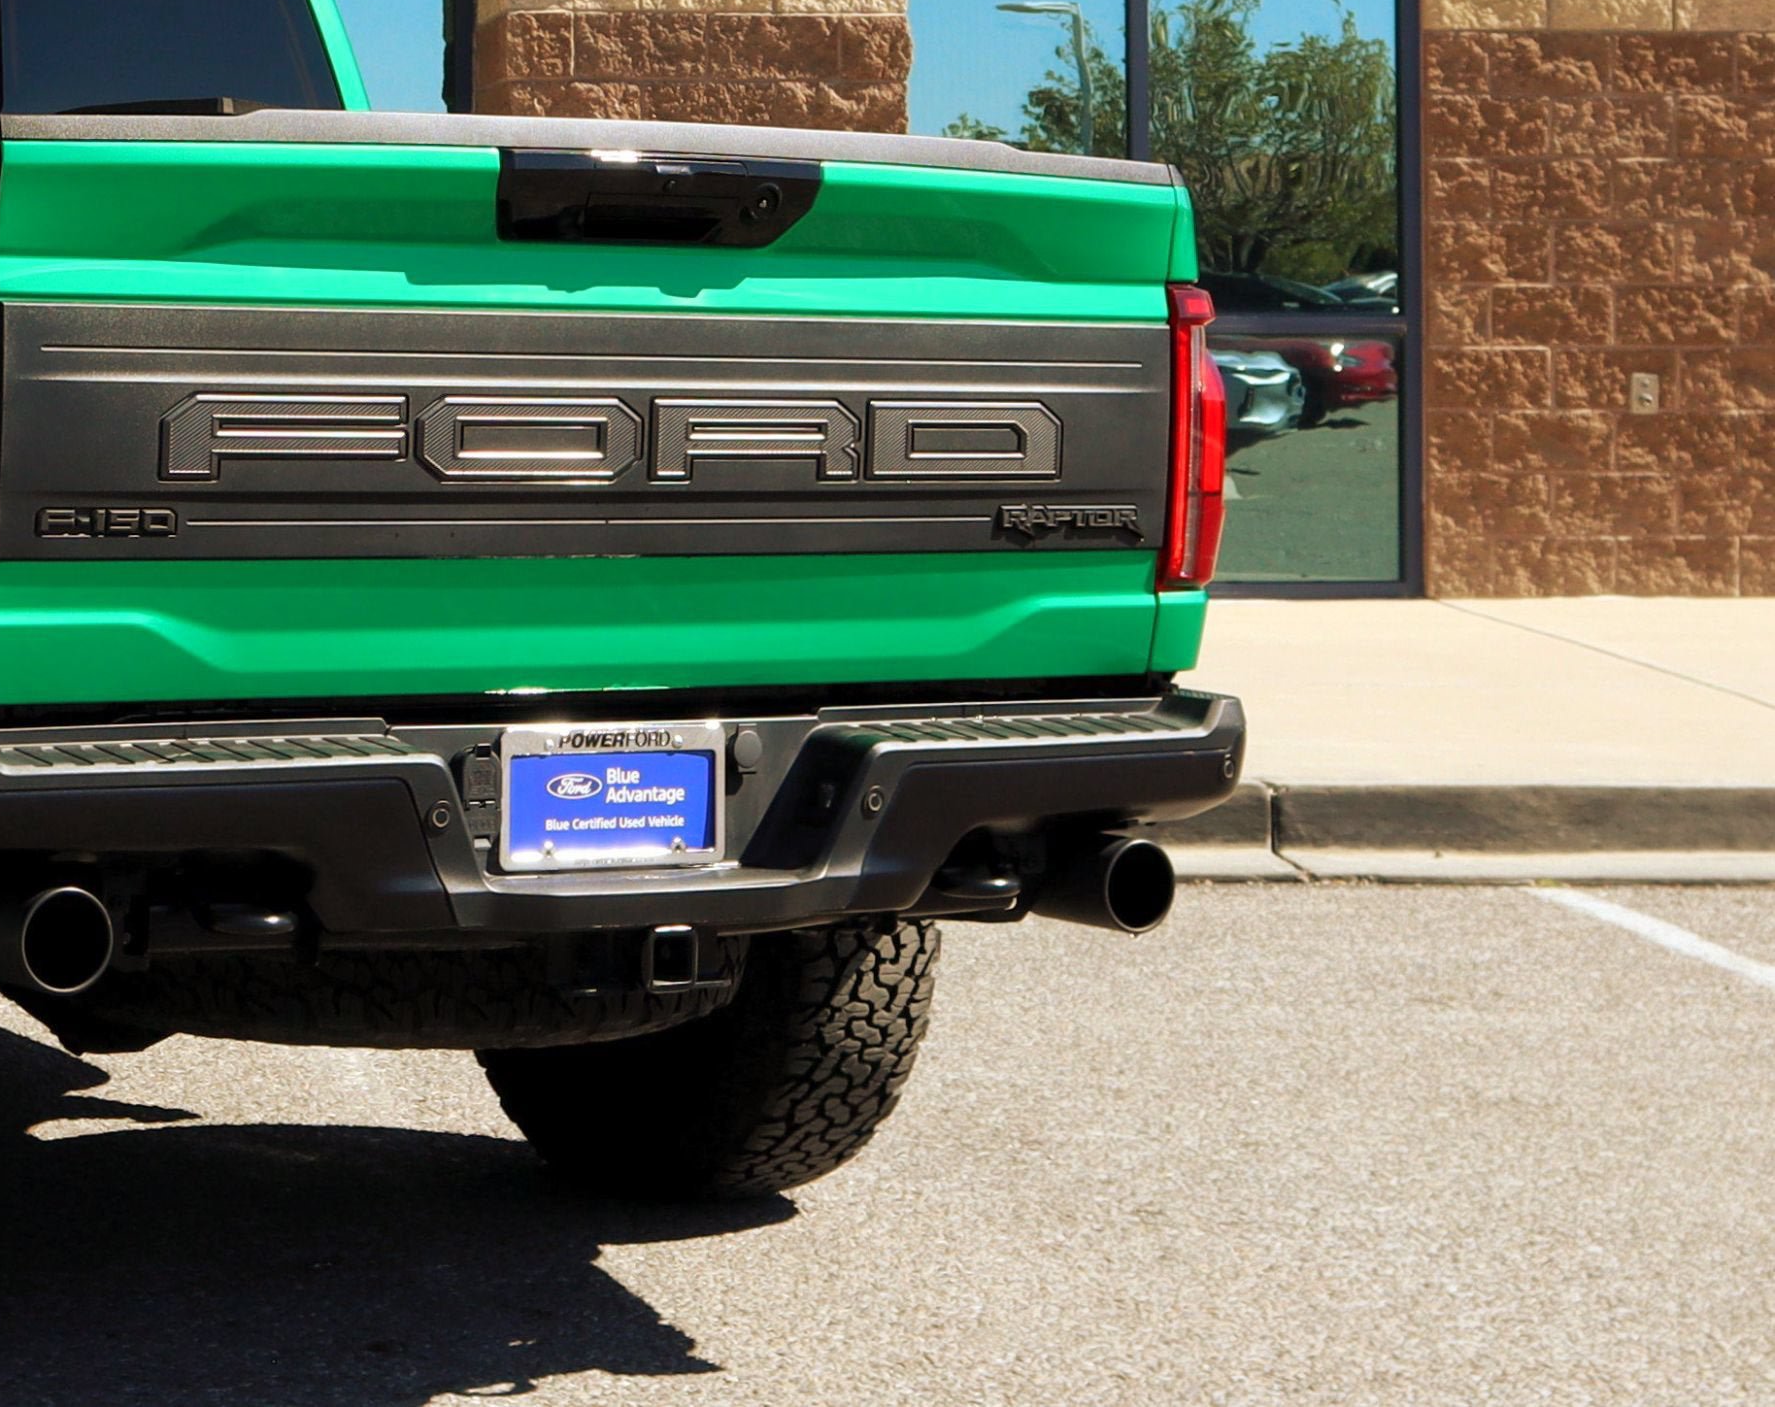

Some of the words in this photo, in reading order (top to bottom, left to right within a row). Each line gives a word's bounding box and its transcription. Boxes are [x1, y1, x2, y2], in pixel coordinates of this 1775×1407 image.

[159, 393, 1062, 484] FORD
[998, 503, 1145, 542] RAPTOR
[606, 768, 640, 785] Blue
[557, 777, 592, 795] Ford
[605, 786, 685, 805] Advantage
[545, 819, 570, 831] Blue
[572, 817, 617, 830] Certified
[618, 816, 646, 828] Used
[648, 814, 685, 827] Vehicle
